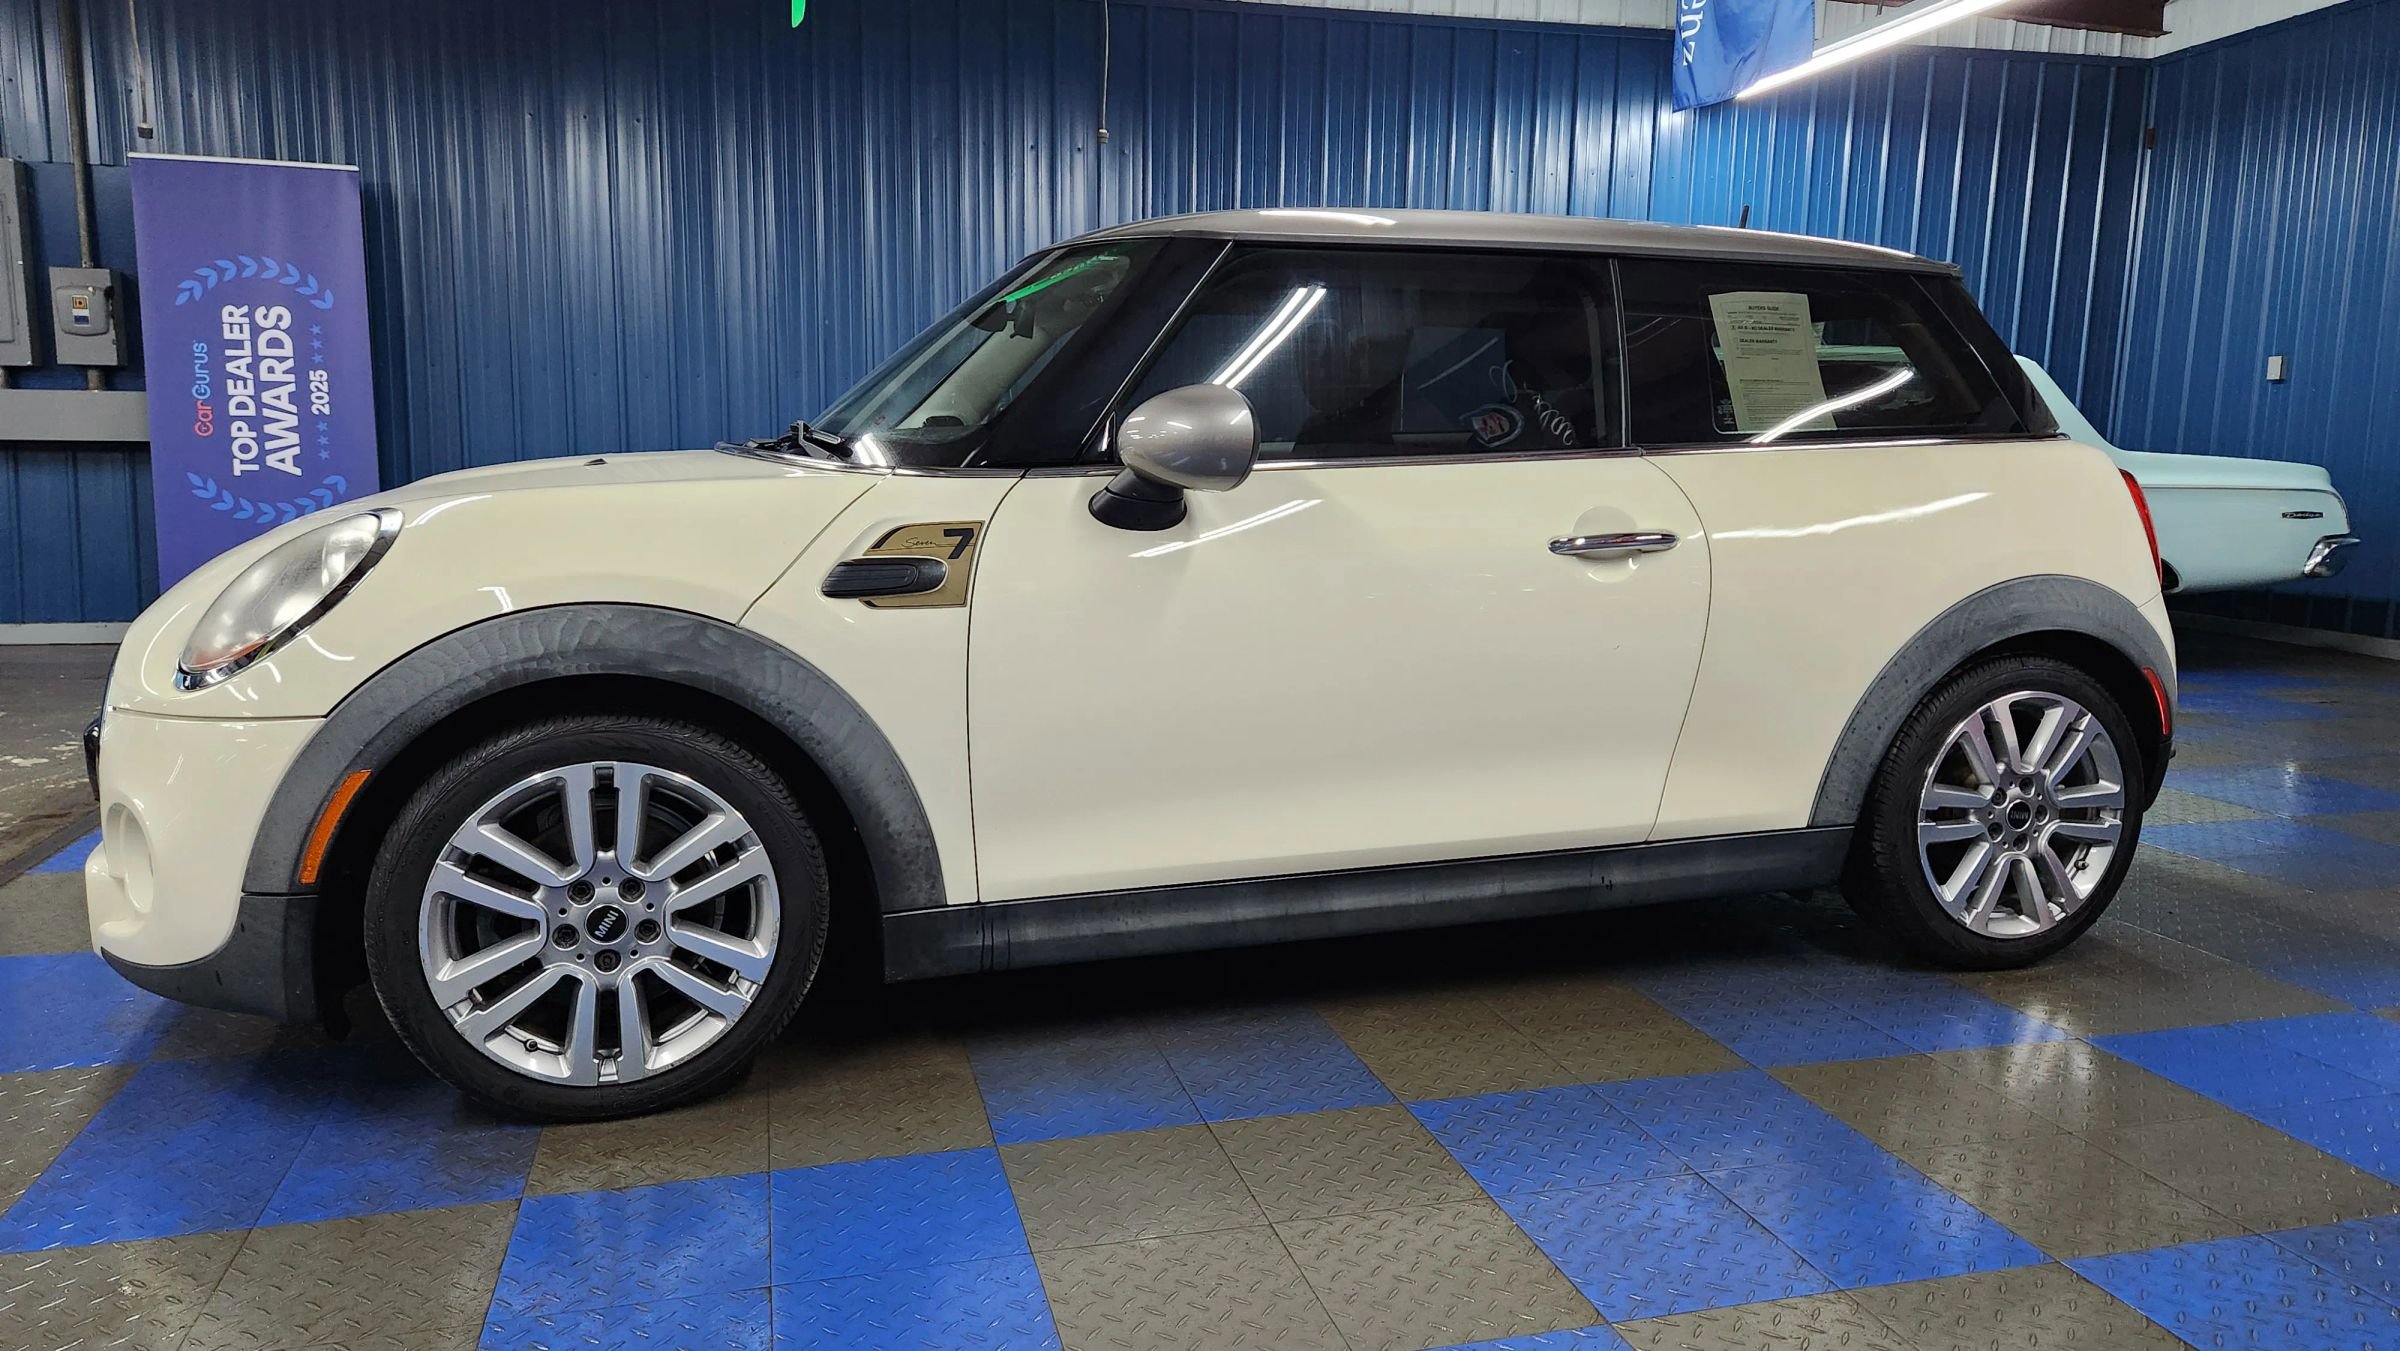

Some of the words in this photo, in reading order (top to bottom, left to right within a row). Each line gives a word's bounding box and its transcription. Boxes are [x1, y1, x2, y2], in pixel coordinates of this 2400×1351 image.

[221, 304, 256, 417] DEALER
[192, 342, 213, 436] CarGurus
[254, 305, 302, 477] AWARDS
[309, 369, 331, 416] 2025
[230, 420, 260, 477] TOP
[901, 536, 937, 548] Seven
[943, 527, 975, 560] 7
[594, 910, 619, 938] MINI
